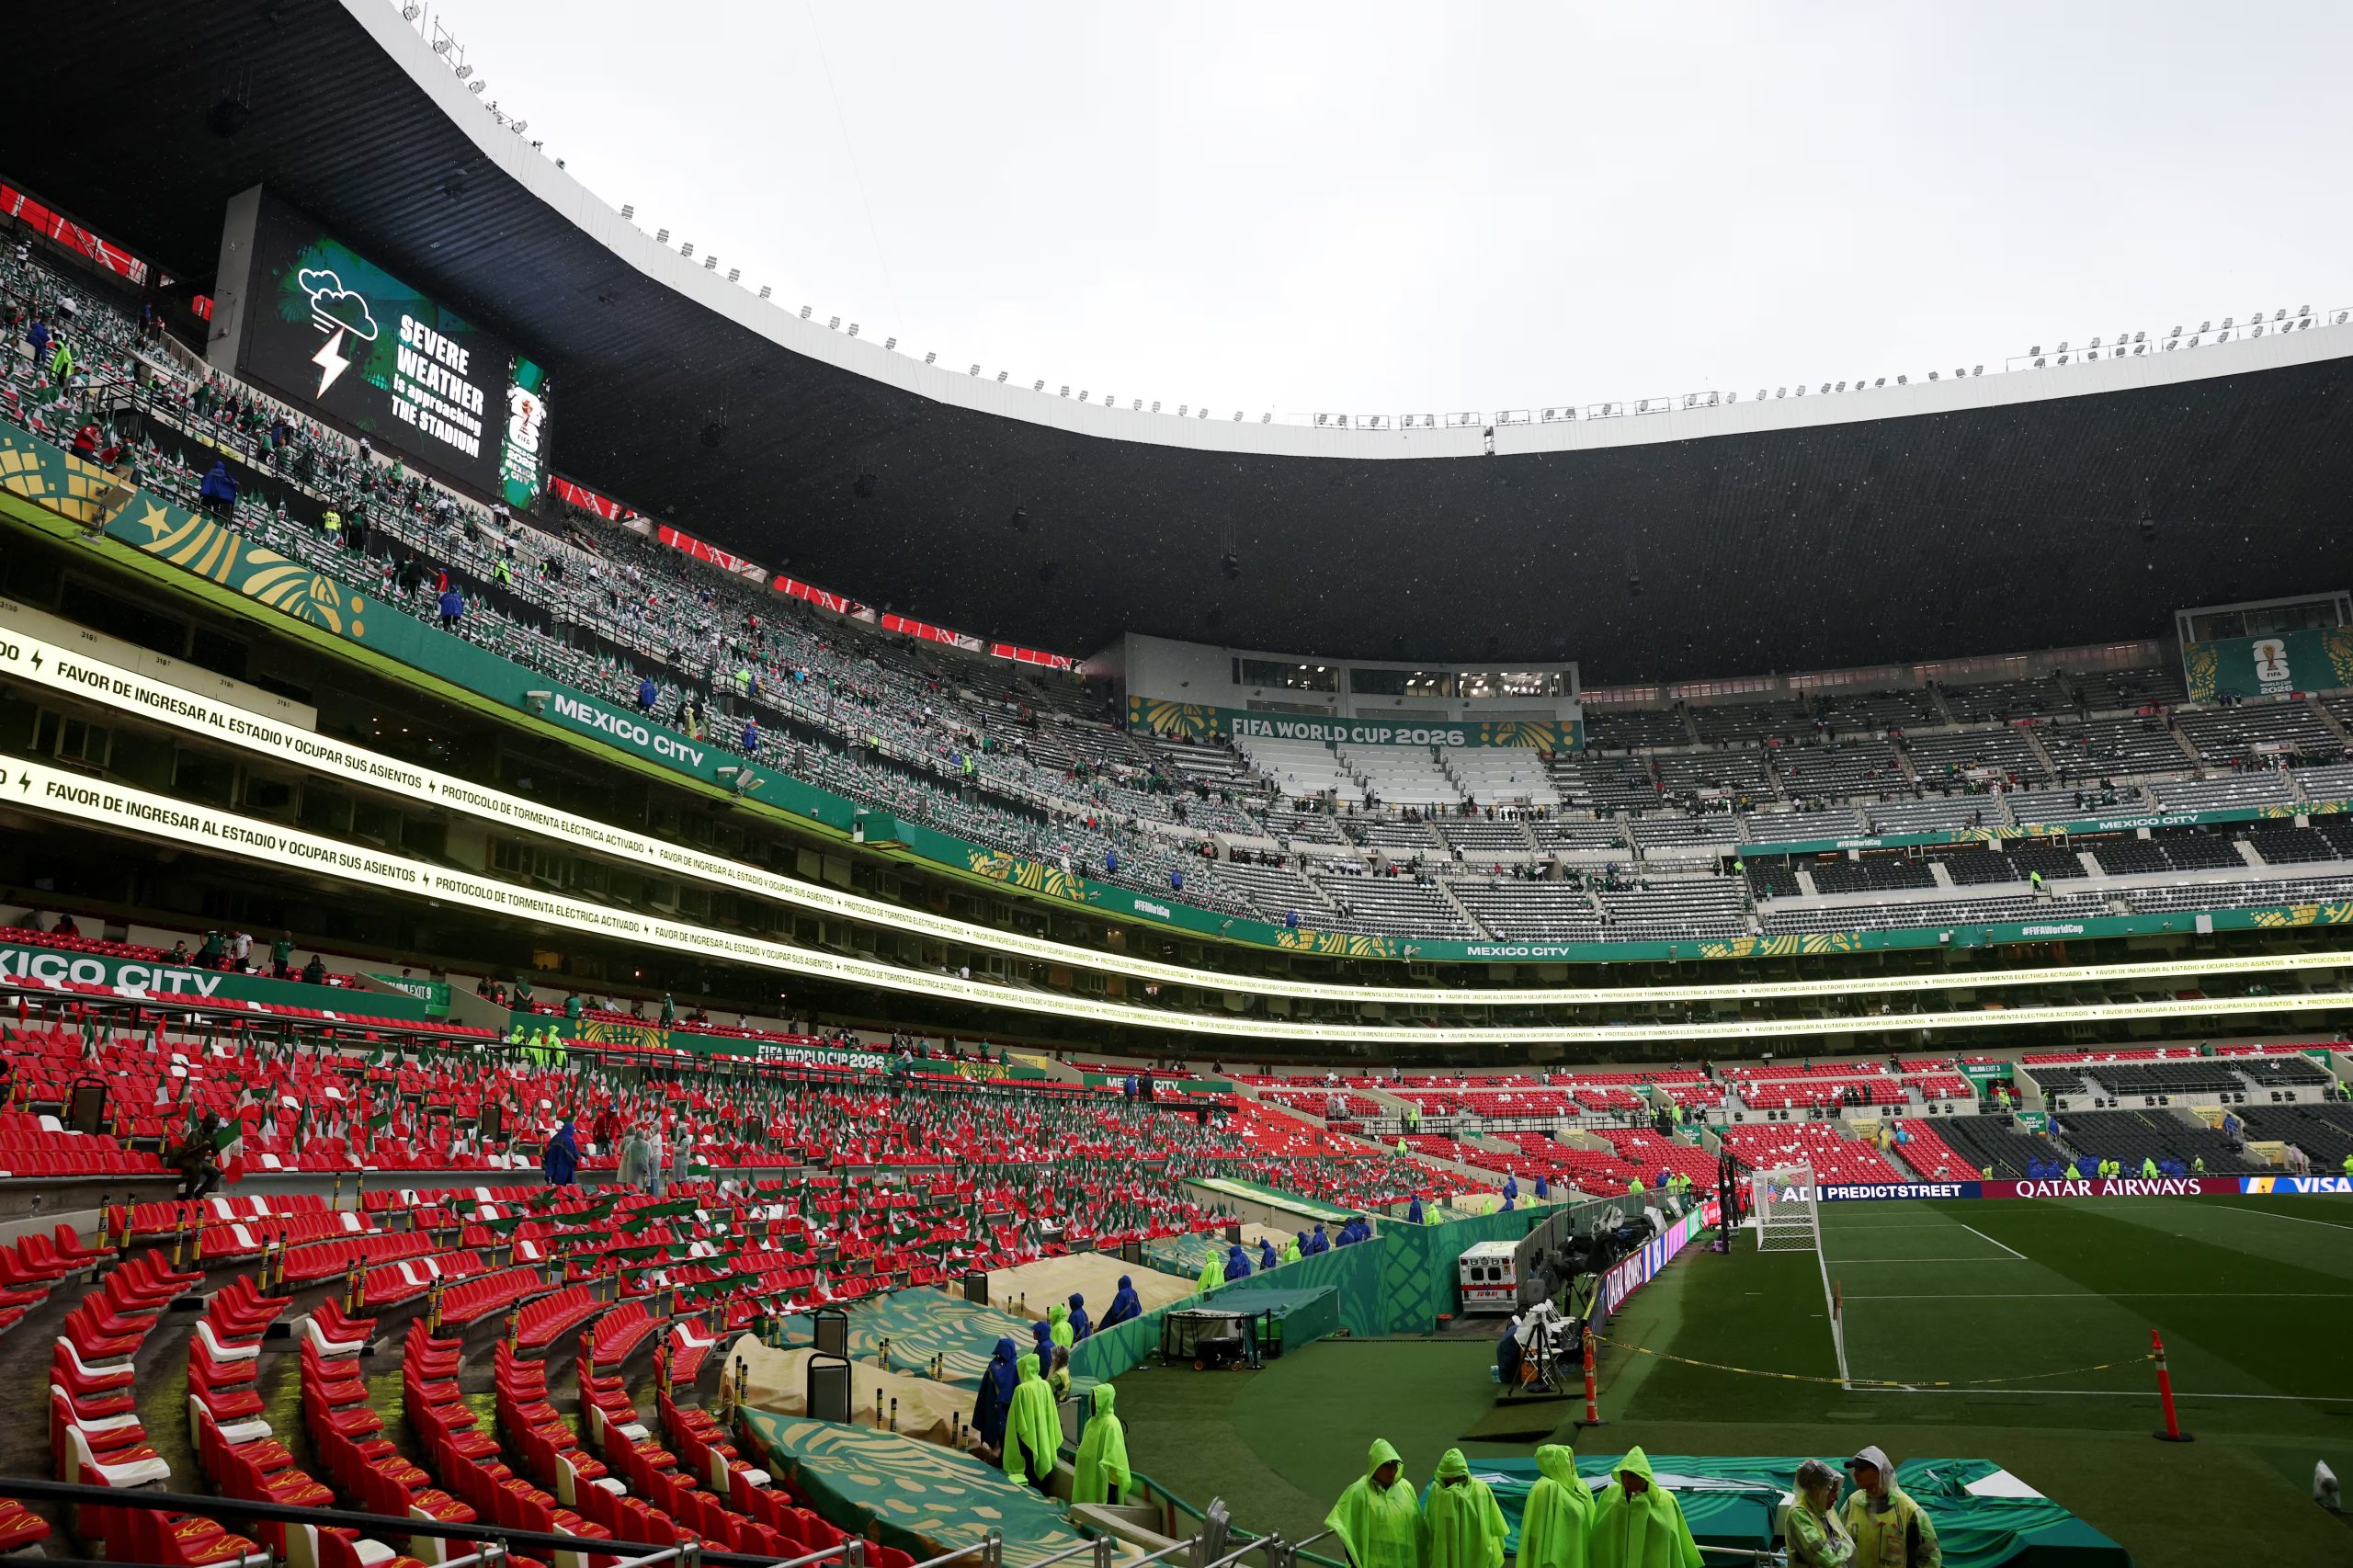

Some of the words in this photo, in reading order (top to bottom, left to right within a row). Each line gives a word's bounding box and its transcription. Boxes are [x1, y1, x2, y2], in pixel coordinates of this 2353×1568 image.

[400, 314, 470, 376] SEVERE
[397, 344, 483, 415] WEATHER
[393, 373, 405, 392] is
[407, 384, 482, 437] approaching
[392, 394, 417, 426] THE
[419, 410, 480, 459] STADIUM
[517, 434, 530, 446] FIFA
[506, 449, 536, 471] 2026
[506, 460, 537, 481] MEXICO
[155, 656, 171, 666] 3197
[2260, 686, 2293, 694] 2026
[57, 662, 109, 690] FAVOR
[112, 680, 131, 698] DE
[134, 687, 206, 722] INGRESAR
[209, 712, 225, 728] AL
[229, 719, 281, 744] ESTADIO
[285, 736, 292, 747] Y
[294, 740, 342, 764] OCUPAR
[344, 756, 367, 771] SUS
[369, 764, 421, 788] ASIENTOS
[554, 693, 649, 745] MEXICO
[654, 734, 704, 767] CITY
[1232, 718, 1274, 736] FIFA
[1276, 721, 1348, 742] WORLD
[1351, 727, 1392, 744] CUP
[1394, 729, 1465, 745] 2026
[46, 782, 99, 807] FAVOR
[103, 796, 122, 812] DE
[125, 801, 199, 831] INGRESAR
[201, 821, 218, 835] AL
[222, 825, 275, 848] ESTADIO
[278, 839, 286, 851] Y
[289, 842, 336, 863] OCUPAR
[338, 854, 361, 869] SUS
[363, 860, 415, 881] ASIENTOS
[441, 785, 498, 810] PROTOCOLO
[500, 802, 511, 814] DE
[513, 807, 559, 827] TORMENTA
[561, 822, 603, 840] ELÉCTRICA
[605, 835, 643, 852] ACTIVADO
[2099, 818, 2158, 829] MEXICO
[2162, 814, 2198, 825] CITY
[1836, 838, 1882, 848] #FIFAWorldCup
[659, 849, 682, 863] FAVOR
[683, 857, 691, 866] DE
[693, 859, 726, 875] INGRESAR
[727, 869, 735, 879] AL
[737, 871, 762, 885] ESTADIO
[768, 881, 792, 893] OCUPAR
[793, 888, 805, 897] SUS
[806, 892, 834, 904] ASIENTOS
[436, 878, 493, 899] PROTOCOLO
[494, 892, 506, 903] DE
[507, 894, 553, 913] TORMENTA
[555, 906, 598, 923] ELÉCTRICA
[600, 916, 639, 931] ACTIVADO
[844, 901, 876, 915] PROTOCOLO
[884, 911, 912, 923] TORMENTA
[939, 924, 963, 935] ACTIVADO
[2022, 924, 2084, 936] #FIFAWorldCup
[654, 927, 678, 939] FAVOR
[679, 932, 688, 942] DE
[689, 935, 723, 949] INGRESAR
[724, 941, 733, 950] AL
[733, 943, 760, 956] ESTADIO
[767, 949, 790, 961] OCUPAR
[791, 955, 803, 964] SUS
[804, 958, 833, 970] ASIENTOS
[1467, 947, 1529, 956] MEXICO
[1531, 947, 1569, 956] CITY
[117, 965, 222, 998] CITY
[409, 985, 426, 999] EXIT
[426, 986, 432, 999] 9
[843, 965, 875, 977] PROTOCOLO
[883, 972, 912, 983] TORMENTA
[939, 983, 963, 993] ACTIVADO
[758, 1045, 783, 1061] FIFA
[785, 1049, 825, 1065] WORLD
[827, 1051, 848, 1066] CUP
[850, 1054, 885, 1069] 2026
[1154, 1080, 1179, 1090] CITY
[1828, 1185, 1962, 1199] PREDICTSTREET
[2016, 1179, 2093, 1199] QATAR
[2101, 1178, 2201, 1196] AIRWAYS
[2288, 1176, 2353, 1193] VISA
[1607, 1266, 1625, 1314] QATAR
[1624, 1252, 1643, 1295] AIRWAYS
